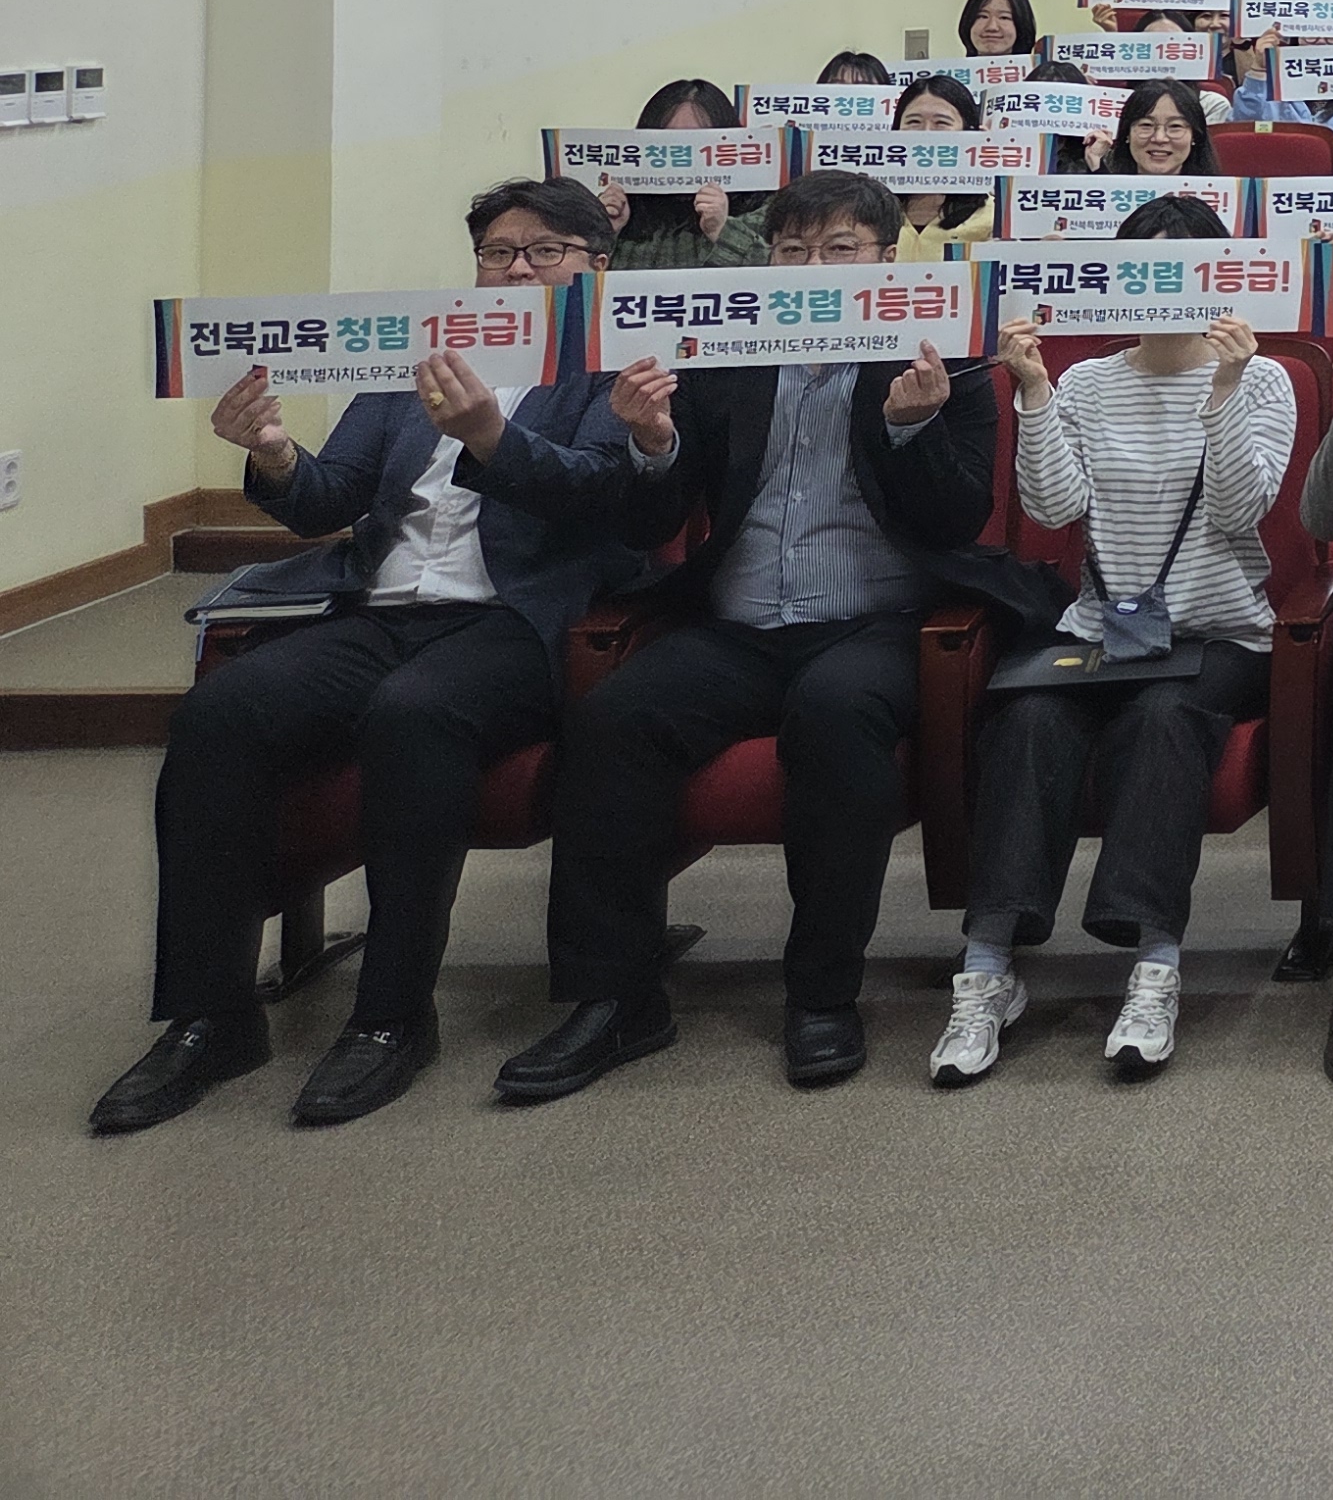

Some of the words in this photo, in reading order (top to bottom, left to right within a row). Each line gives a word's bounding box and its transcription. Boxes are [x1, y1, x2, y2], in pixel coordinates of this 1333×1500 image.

[1246, 2, 1309, 18] 전북교육
[1058, 43, 1115, 60] 전북교육
[1119, 43, 1151, 60] 청렴
[1156, 37, 1203, 60] 1등급!
[753, 97, 830, 115] 전북교육
[834, 97, 874, 116] 청렴
[987, 94, 1040, 116] 전북교육
[1045, 94, 1082, 114] 청렴
[564, 144, 642, 167] 전북교육
[645, 145, 692, 167] 청렴
[700, 135, 771, 166] 1등급!
[818, 144, 907, 167] 전북교육
[912, 145, 958, 167] 청렴
[965, 138, 1031, 167] 1등급!
[1018, 189, 1106, 211] 전북교육
[1117, 261, 1184, 294] 청렴
[1194, 248, 1289, 293] 1등급!
[612, 292, 760, 329] 전북교육
[768, 289, 842, 325] 청렴
[853, 273, 958, 321] 1등급!
[189, 319, 330, 356] 전북교육
[337, 316, 410, 353] 청렴
[421, 298, 532, 348] 1등급!
[702, 334, 898, 356] 전북특별자치도무주교육지원청
[271, 364, 420, 385] 전북특별자치도무주교육
